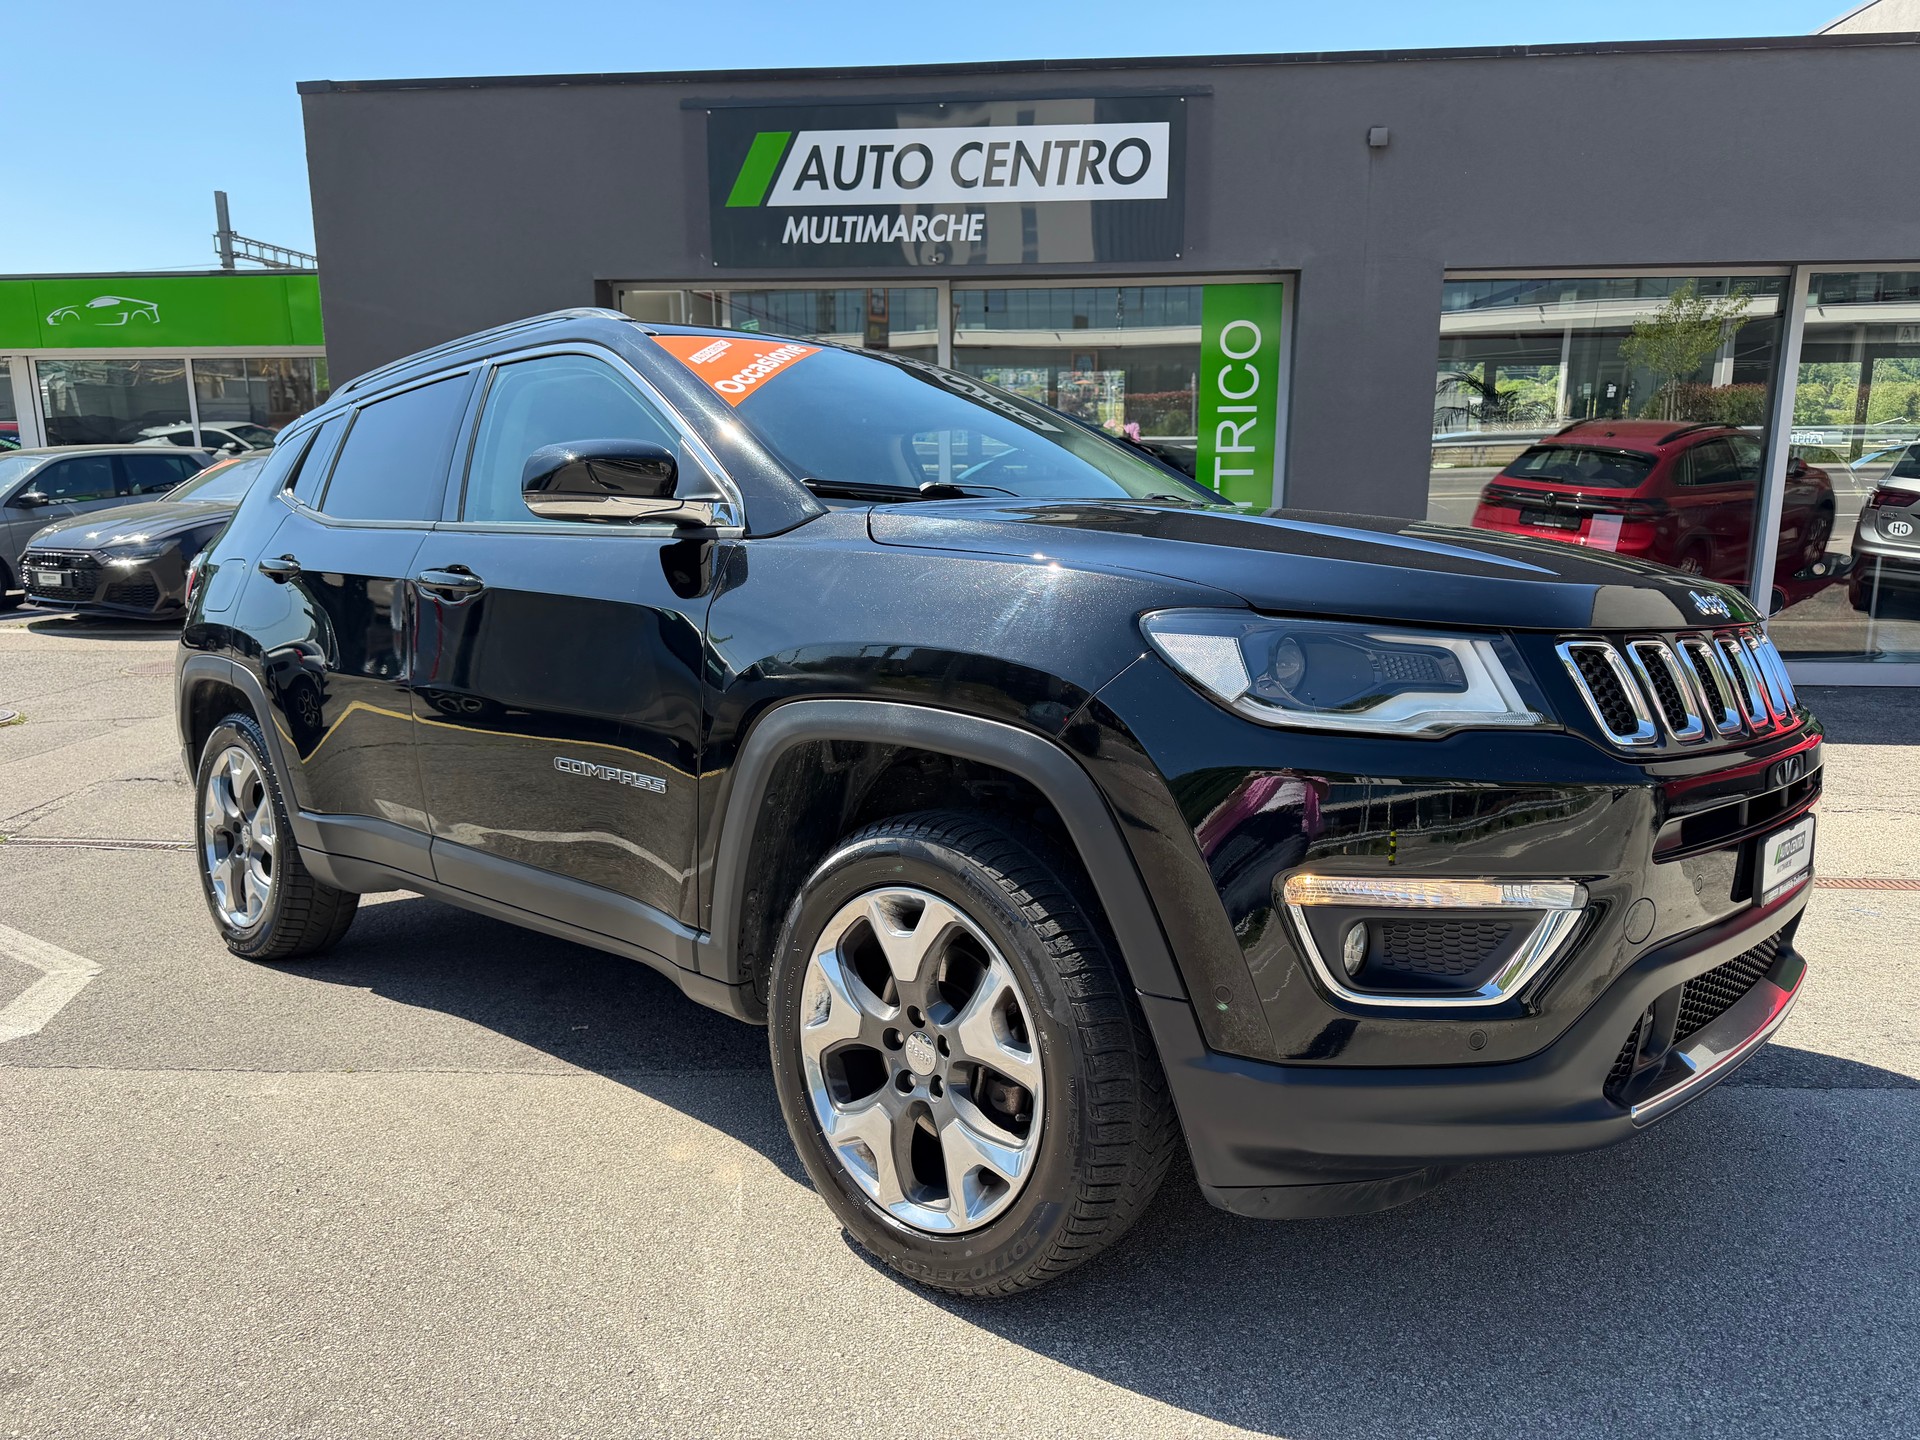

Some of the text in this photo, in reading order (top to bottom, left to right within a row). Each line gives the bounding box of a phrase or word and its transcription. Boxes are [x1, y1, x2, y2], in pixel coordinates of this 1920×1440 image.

[793, 137, 1153, 192] AUTO CENTRO
[781, 213, 986, 244] MULTIMARCHE
[714, 344, 808, 393] Occasione
[1213, 319, 1262, 507] TRICO
[553, 756, 668, 794] COMPASS
